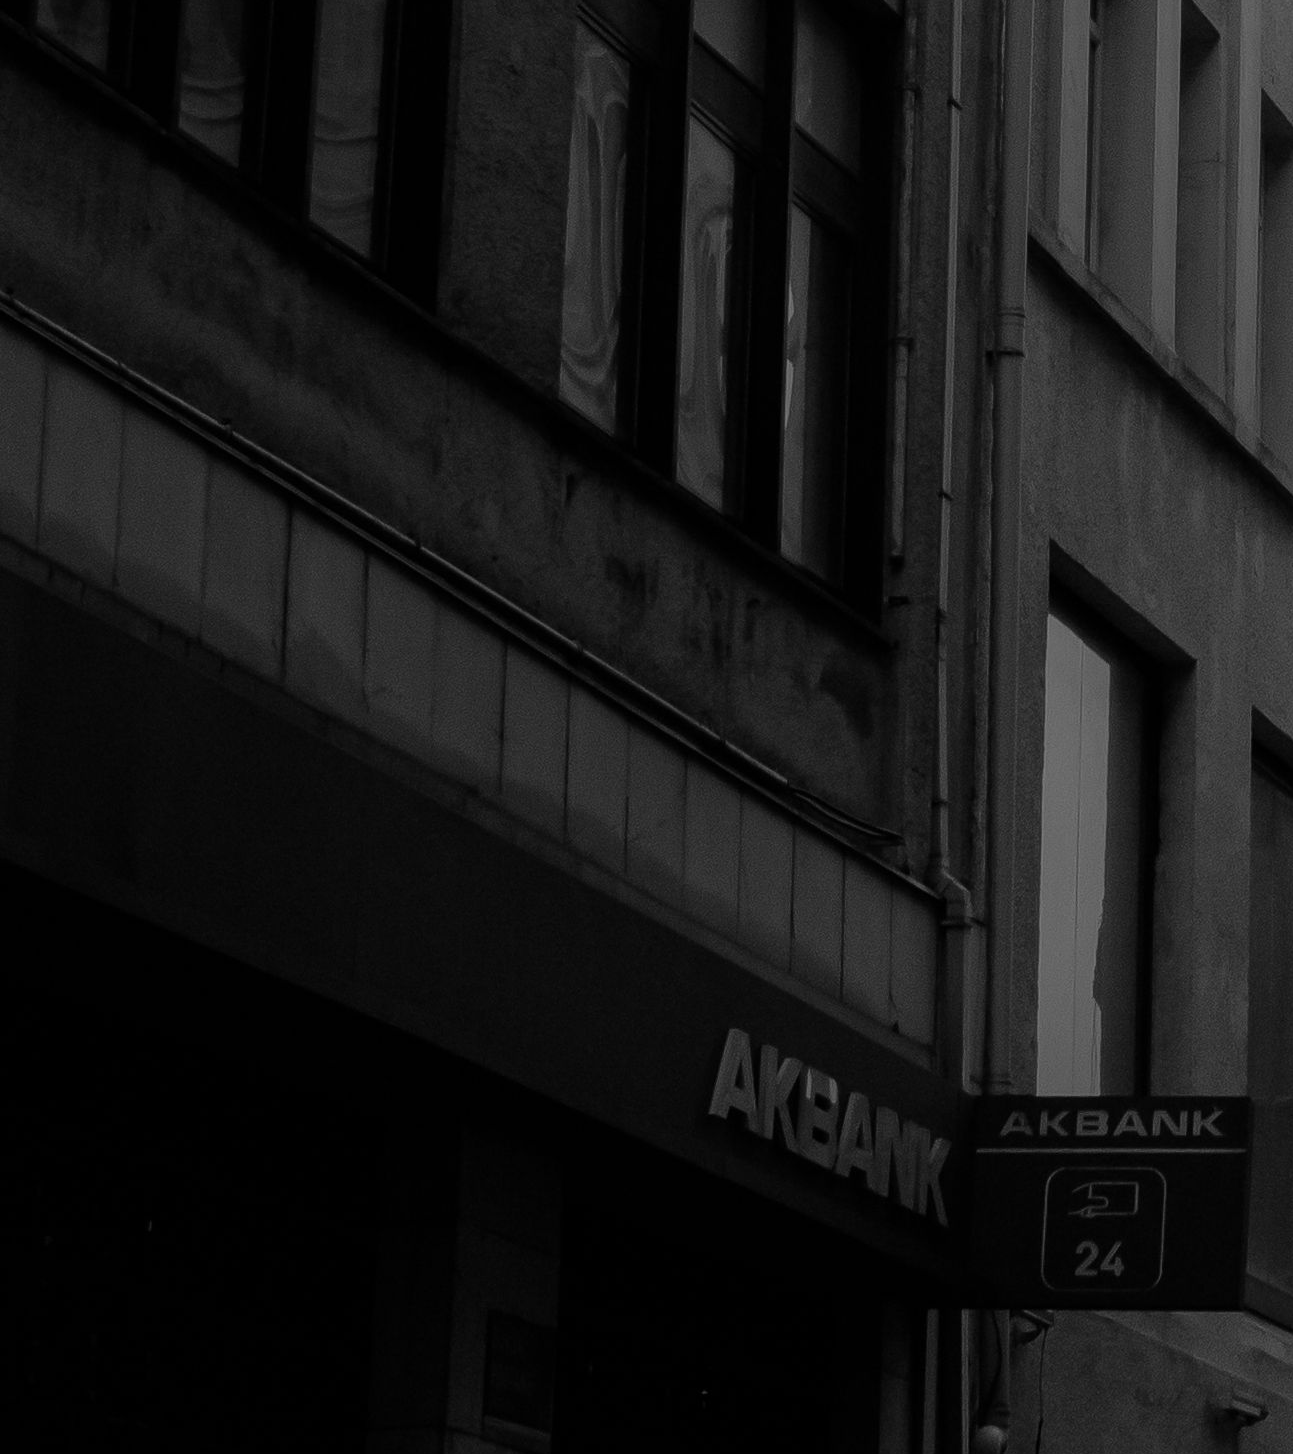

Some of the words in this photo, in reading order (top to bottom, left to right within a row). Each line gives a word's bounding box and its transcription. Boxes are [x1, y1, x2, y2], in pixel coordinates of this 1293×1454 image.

[708, 1027, 952, 1228] AKBANK
[998, 1106, 1224, 1138] AKBANK
[1074, 1240, 1125, 1277] 24
